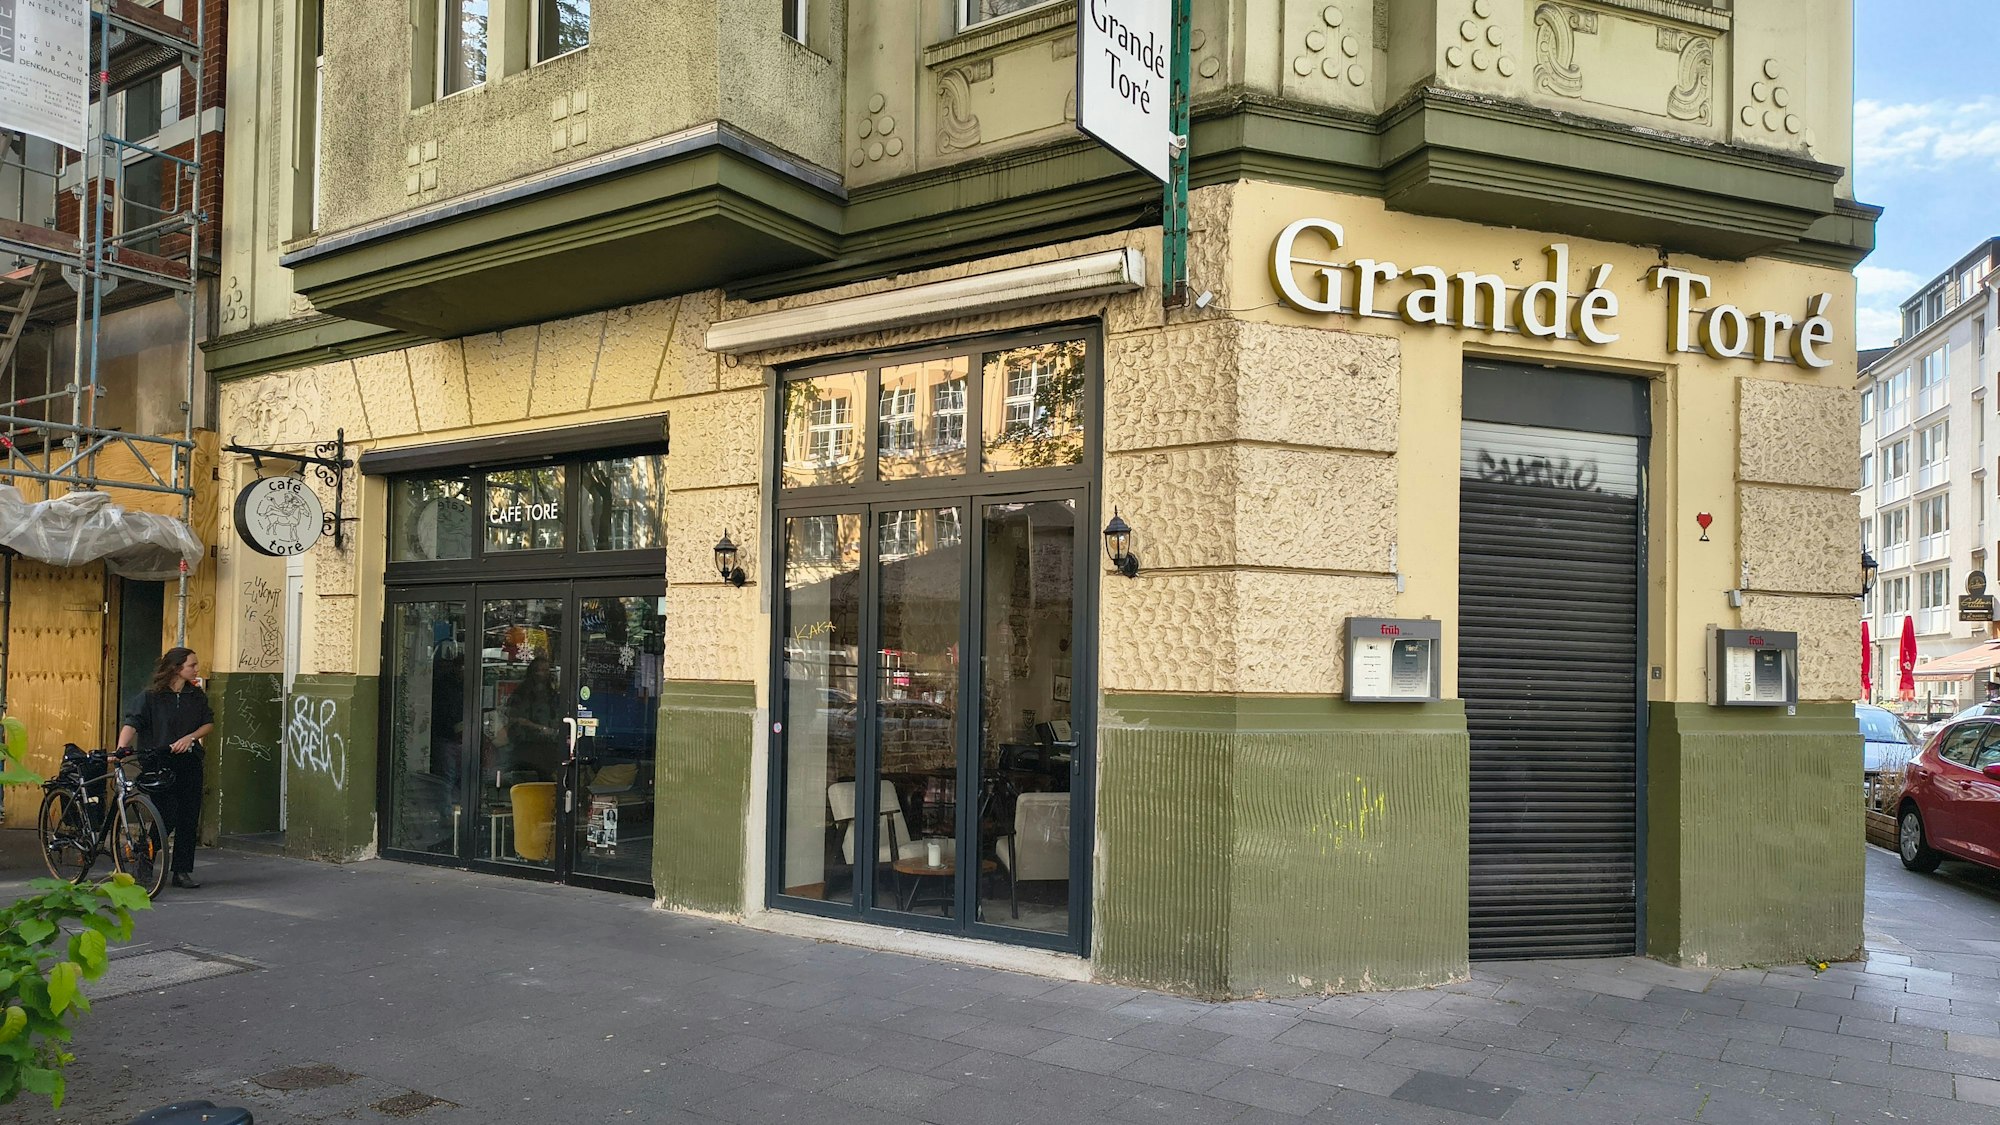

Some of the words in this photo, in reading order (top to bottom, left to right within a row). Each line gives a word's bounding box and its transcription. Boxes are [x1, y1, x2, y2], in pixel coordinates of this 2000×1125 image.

[22, 0, 83, 28] INTERIEUR
[20, 33, 83, 61] NEUBAU
[1091, 0, 1164, 79] Grandé
[20, 45, 83, 73] UMBAU
[20, 58, 82, 86] DENKMALSCHUTZ
[1105, 48, 1150, 114] Toré
[1268, 217, 1620, 346] Grandé
[1648, 266, 1834, 369] Toré
[269, 478, 302, 494] café
[490, 502, 522, 524] CAFÉ
[525, 499, 558, 520] TORÉ
[269, 540, 304, 555] toré
[794, 621, 837, 645] KAKA
[1380, 624, 1400, 636] früh
